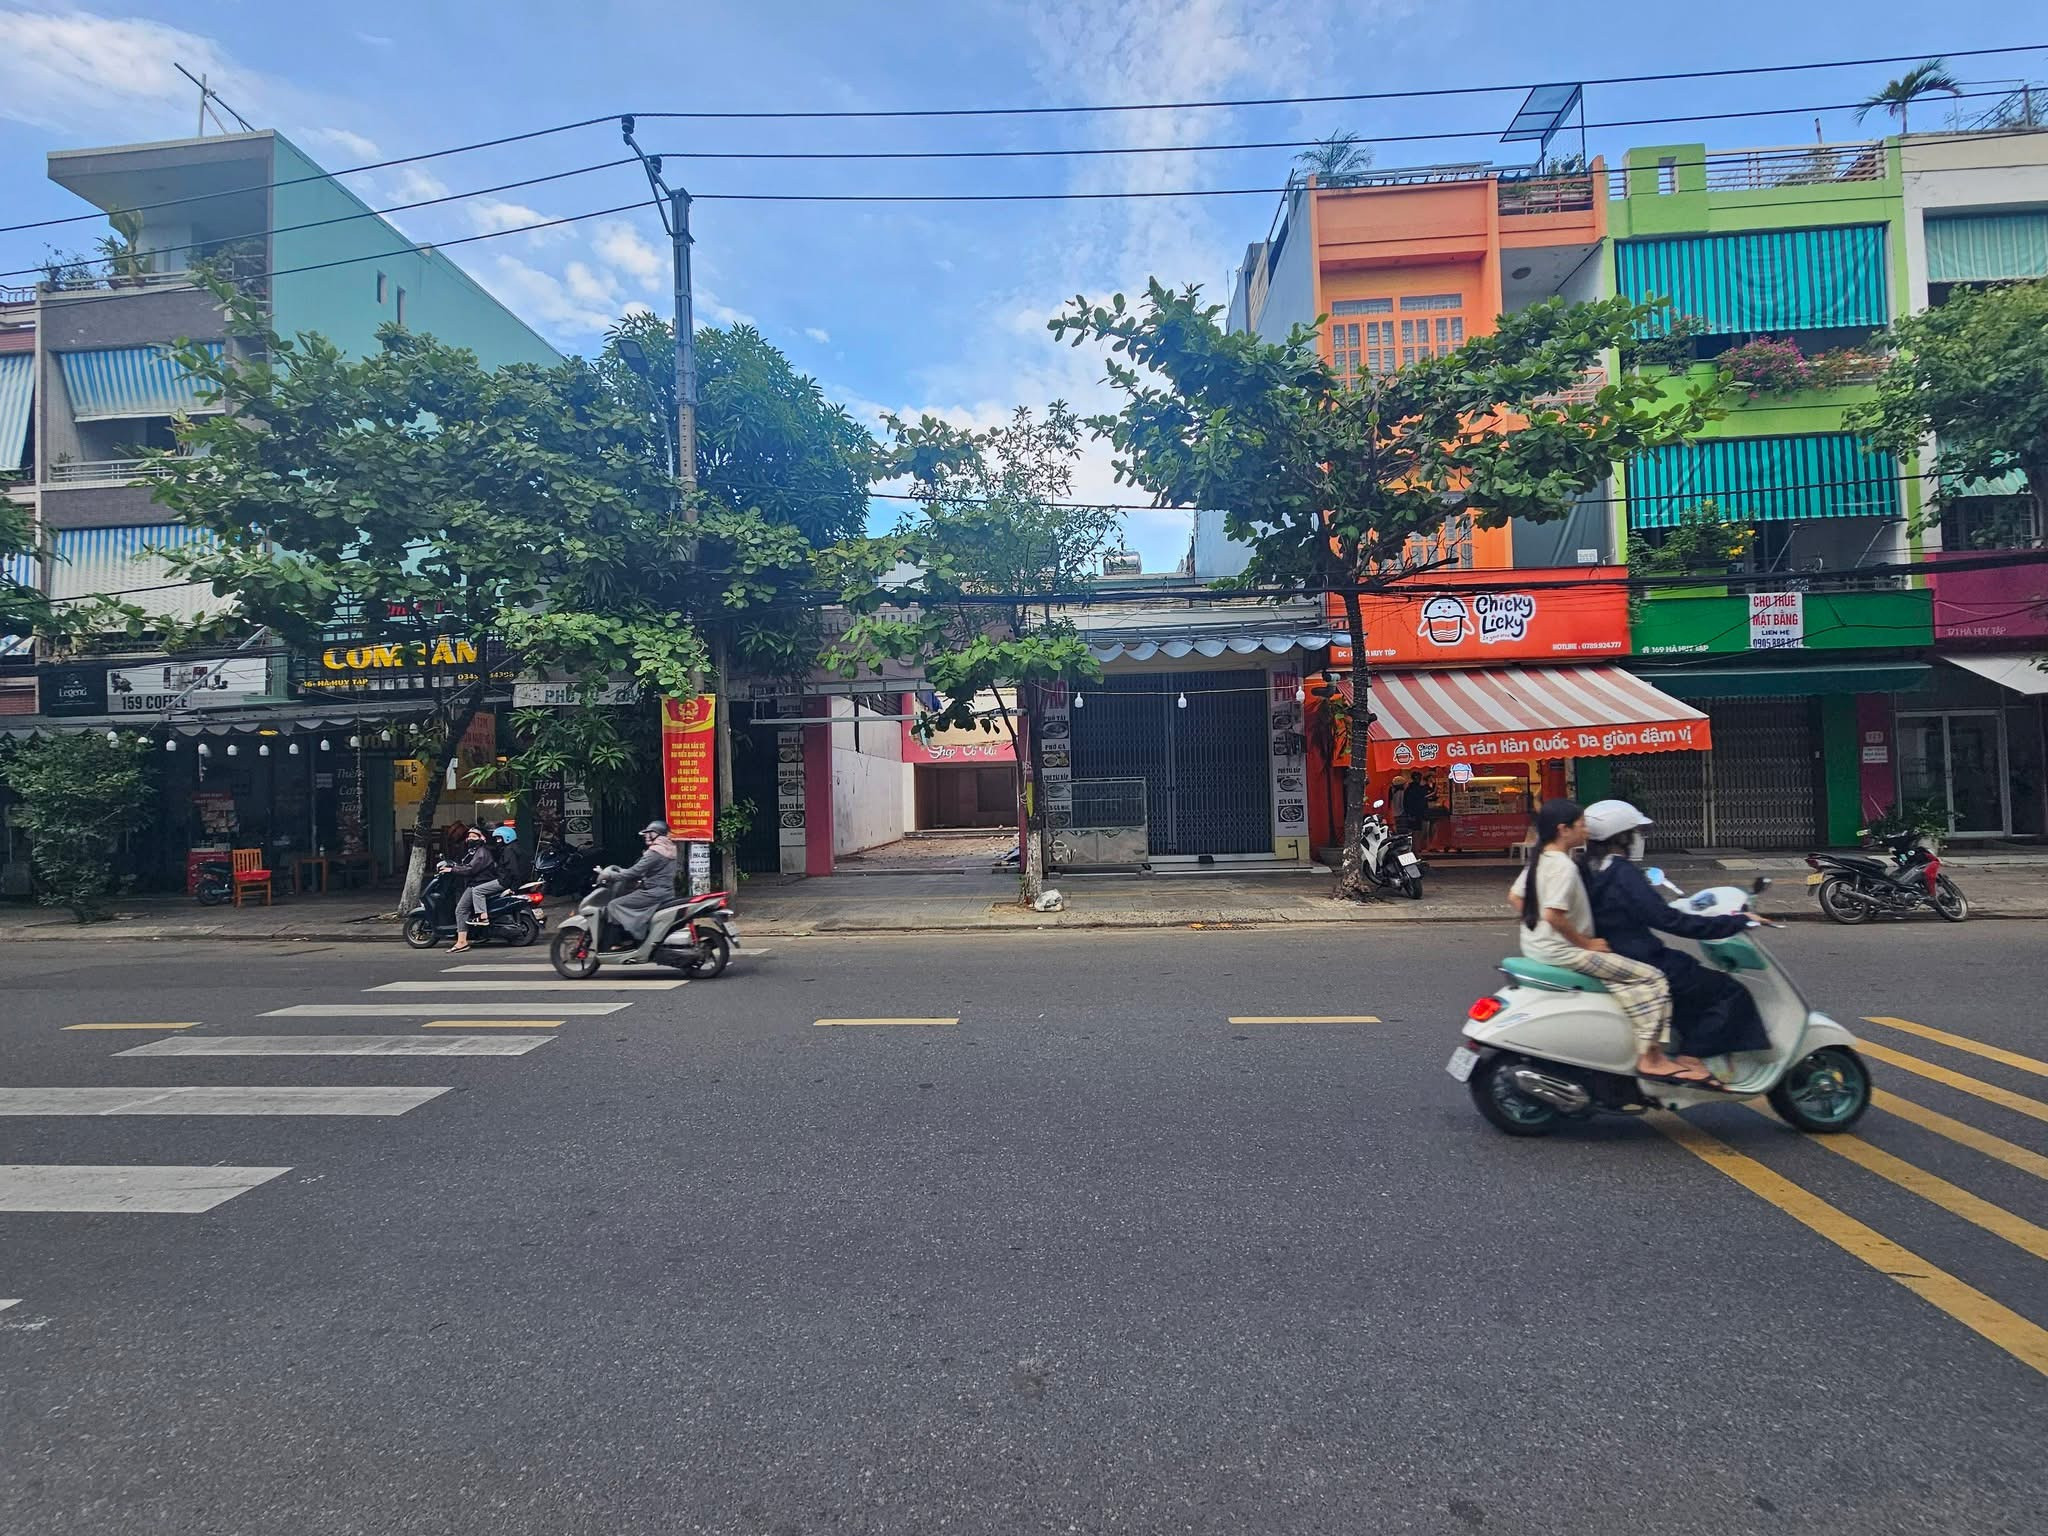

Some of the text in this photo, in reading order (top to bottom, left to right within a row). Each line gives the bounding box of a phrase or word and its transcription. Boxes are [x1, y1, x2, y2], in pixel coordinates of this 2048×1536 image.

[1475, 594, 1533, 618] Chicky
[1753, 595, 1771, 607] CHO
[1482, 614, 1524, 638] Licky
[1773, 609, 1799, 626] BẰNG
[122, 696, 142, 710] 159
[1446, 740, 1468, 757] Gà
[1470, 739, 1497, 756] rán
[1500, 737, 1530, 754] Hàn
[1533, 731, 1570, 752] Quốc
[1578, 734, 1600, 748] Da
[1602, 730, 1637, 751] giòn
[1640, 727, 1676, 747] đậm
[1678, 725, 1692, 744] vị
